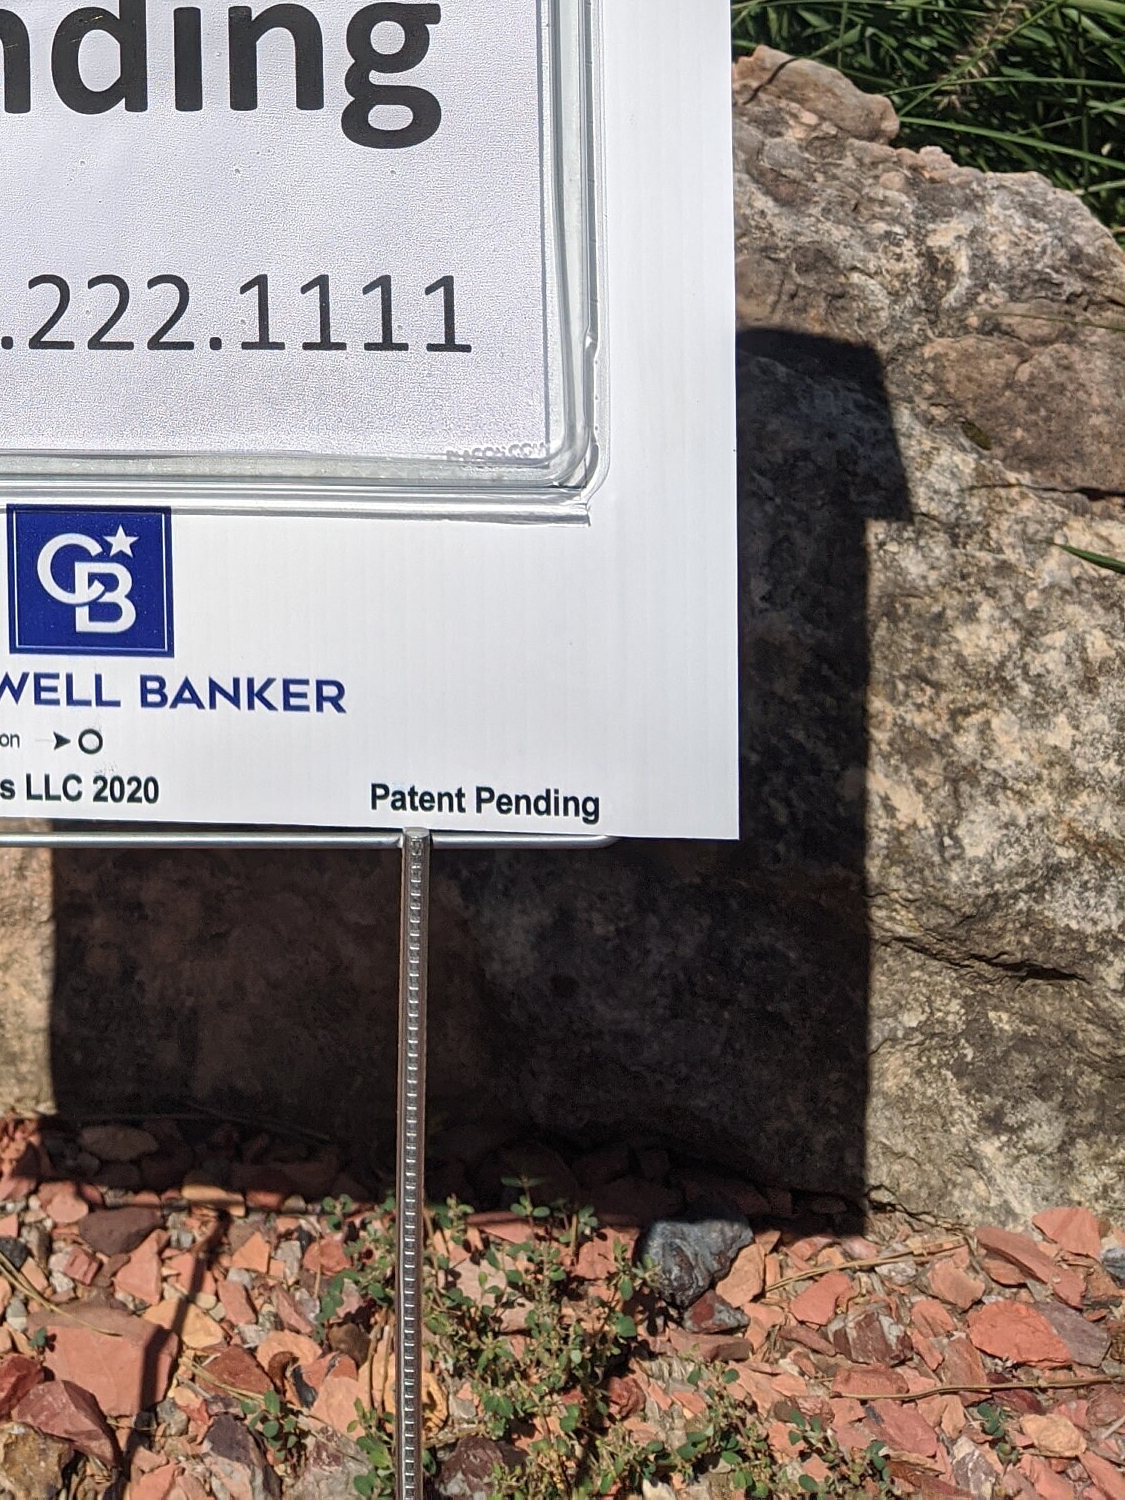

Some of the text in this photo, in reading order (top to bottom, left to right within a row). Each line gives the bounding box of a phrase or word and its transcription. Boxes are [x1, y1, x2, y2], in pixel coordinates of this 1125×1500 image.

[139, 674, 347, 714] BANKER
[25, 773, 83, 802] LLC
[92, 774, 159, 804] 2020
[370, 782, 600, 825] Patent Pending
